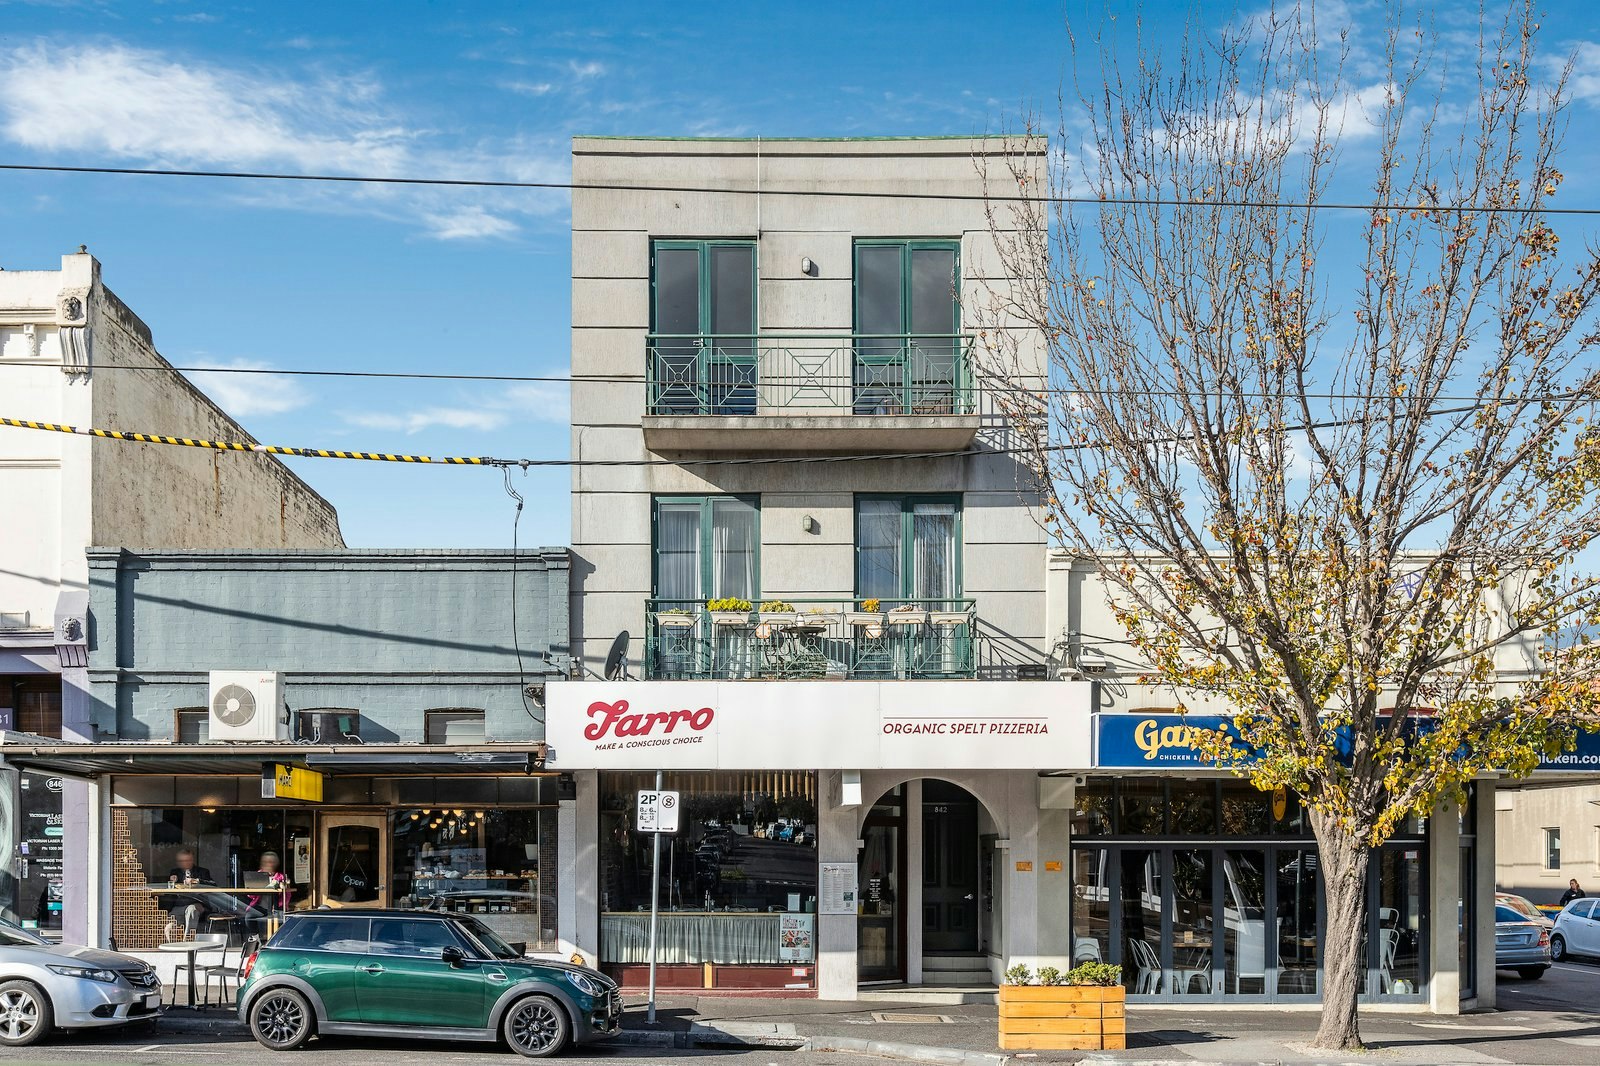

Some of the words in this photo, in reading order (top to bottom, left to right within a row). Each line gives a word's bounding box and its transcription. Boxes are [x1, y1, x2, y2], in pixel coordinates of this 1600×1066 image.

[584, 700, 714, 740] Farro
[883, 723, 946, 734] ORGANIC
[949, 723, 986, 734] SPELT
[989, 723, 1048, 734] PIZZERIA
[595, 743, 617, 751] MAKE
[626, 739, 671, 749] CONSCIOUS
[672, 736, 704, 745] CHOICE
[641, 795, 657, 805] 2P
[344, 875, 364, 887] Open
